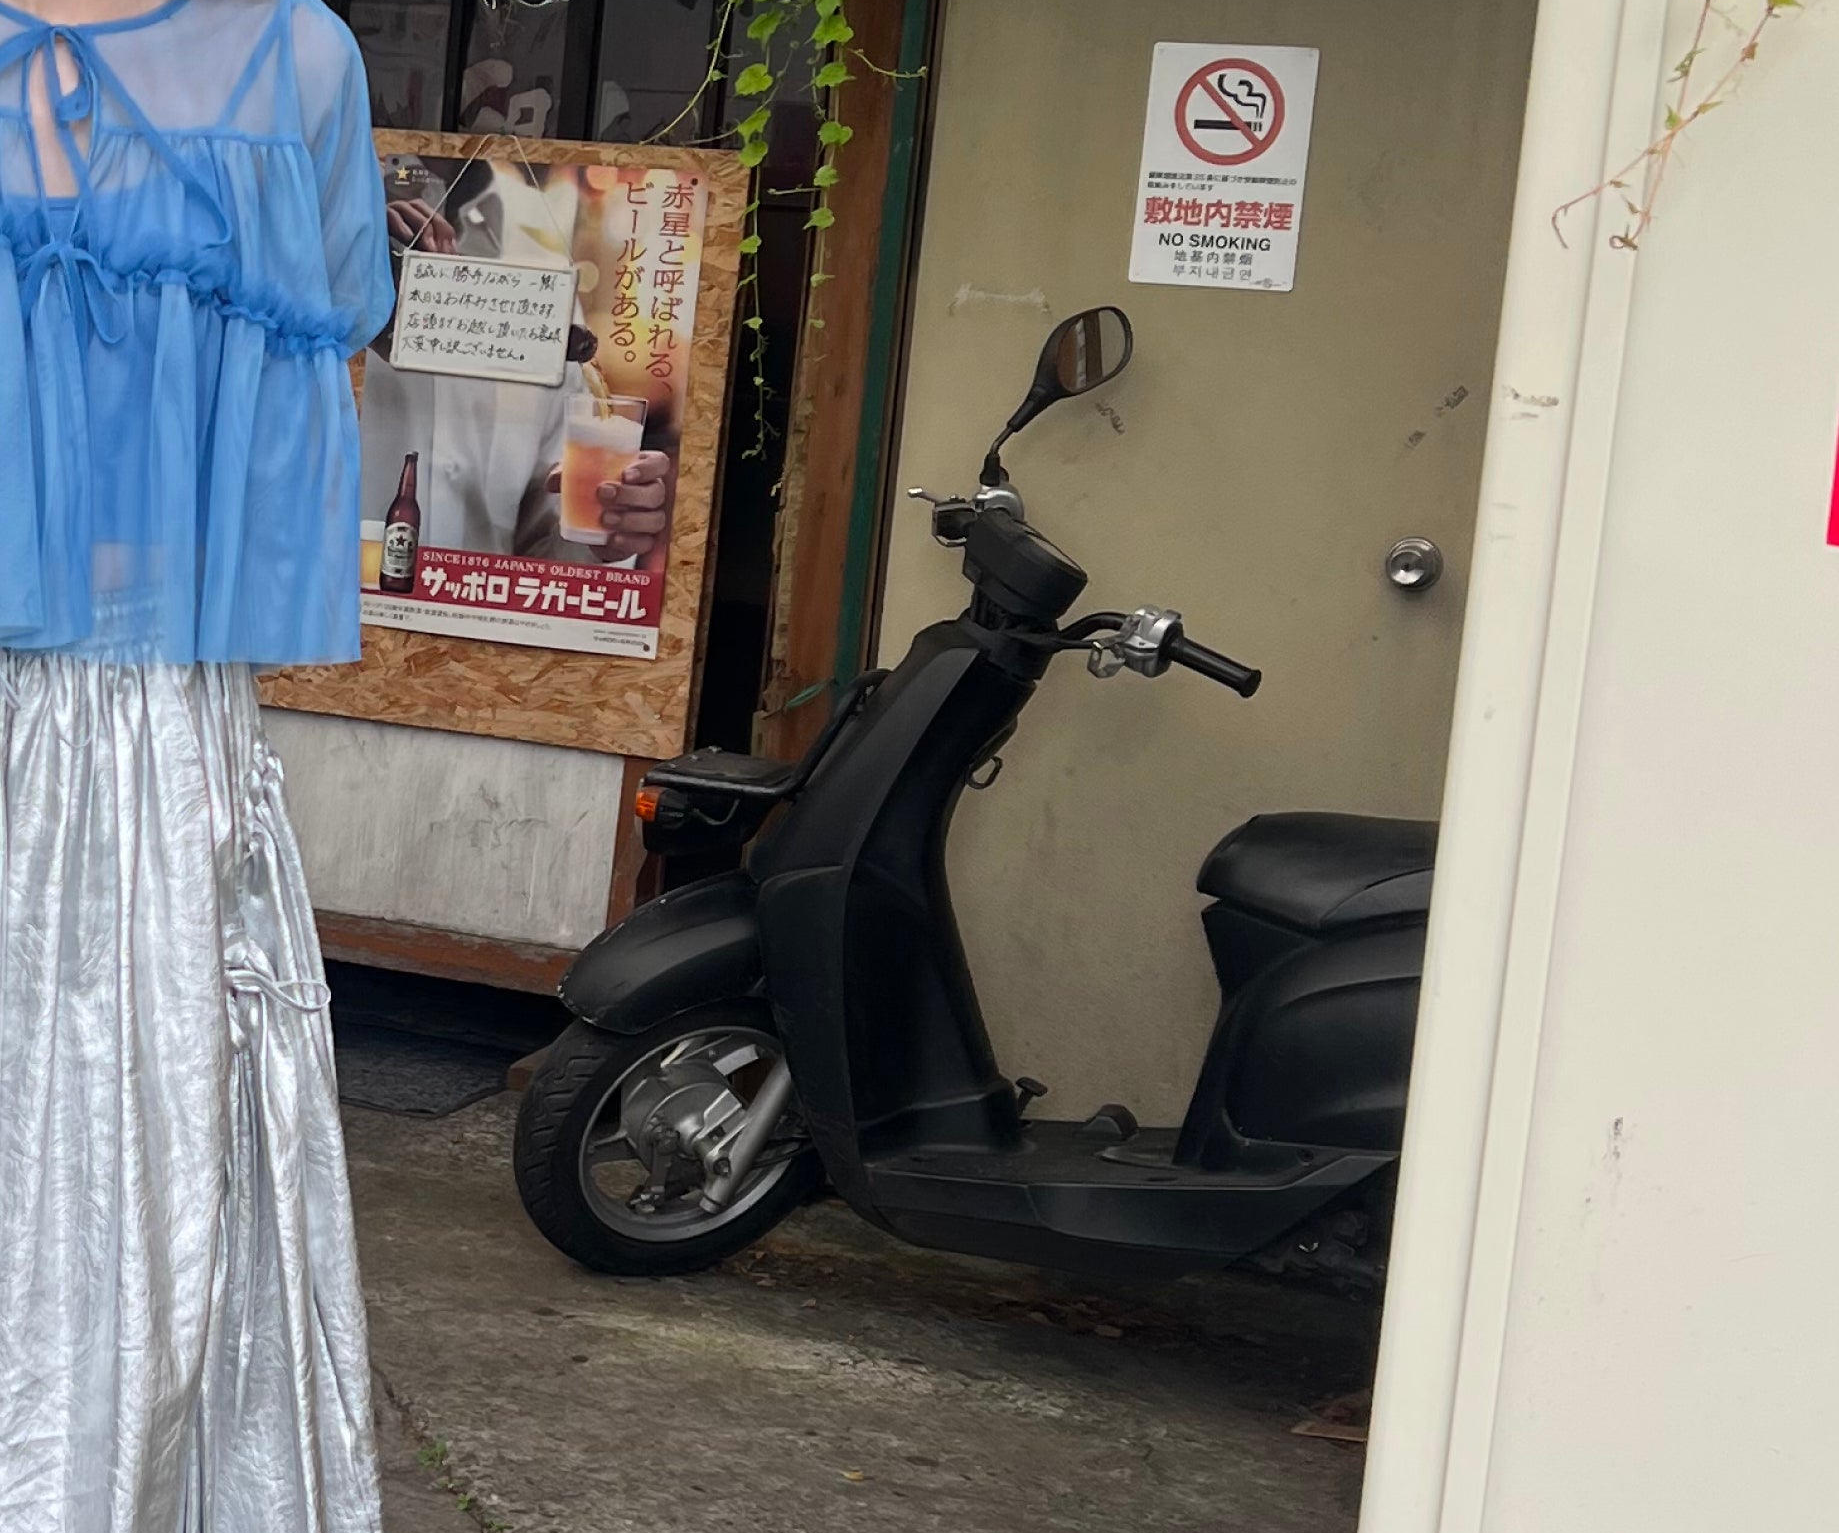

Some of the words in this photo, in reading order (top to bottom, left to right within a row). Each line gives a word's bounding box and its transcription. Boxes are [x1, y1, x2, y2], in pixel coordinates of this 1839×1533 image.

[1143, 196, 1295, 230] 敷地内禁煙
[1158, 232, 1184, 247] NO
[1188, 233, 1272, 252] SMOKING
[609, 181, 654, 363] ビールがある。
[645, 182, 695, 393] 赤星と呼ばれる、
[420, 566, 510, 604] サッポロ
[514, 576, 648, 620] ラガービール
[494, 557, 546, 575] JAPAN'S
[550, 565, 602, 581] OLDEST
[605, 572, 651, 586] BRAND
